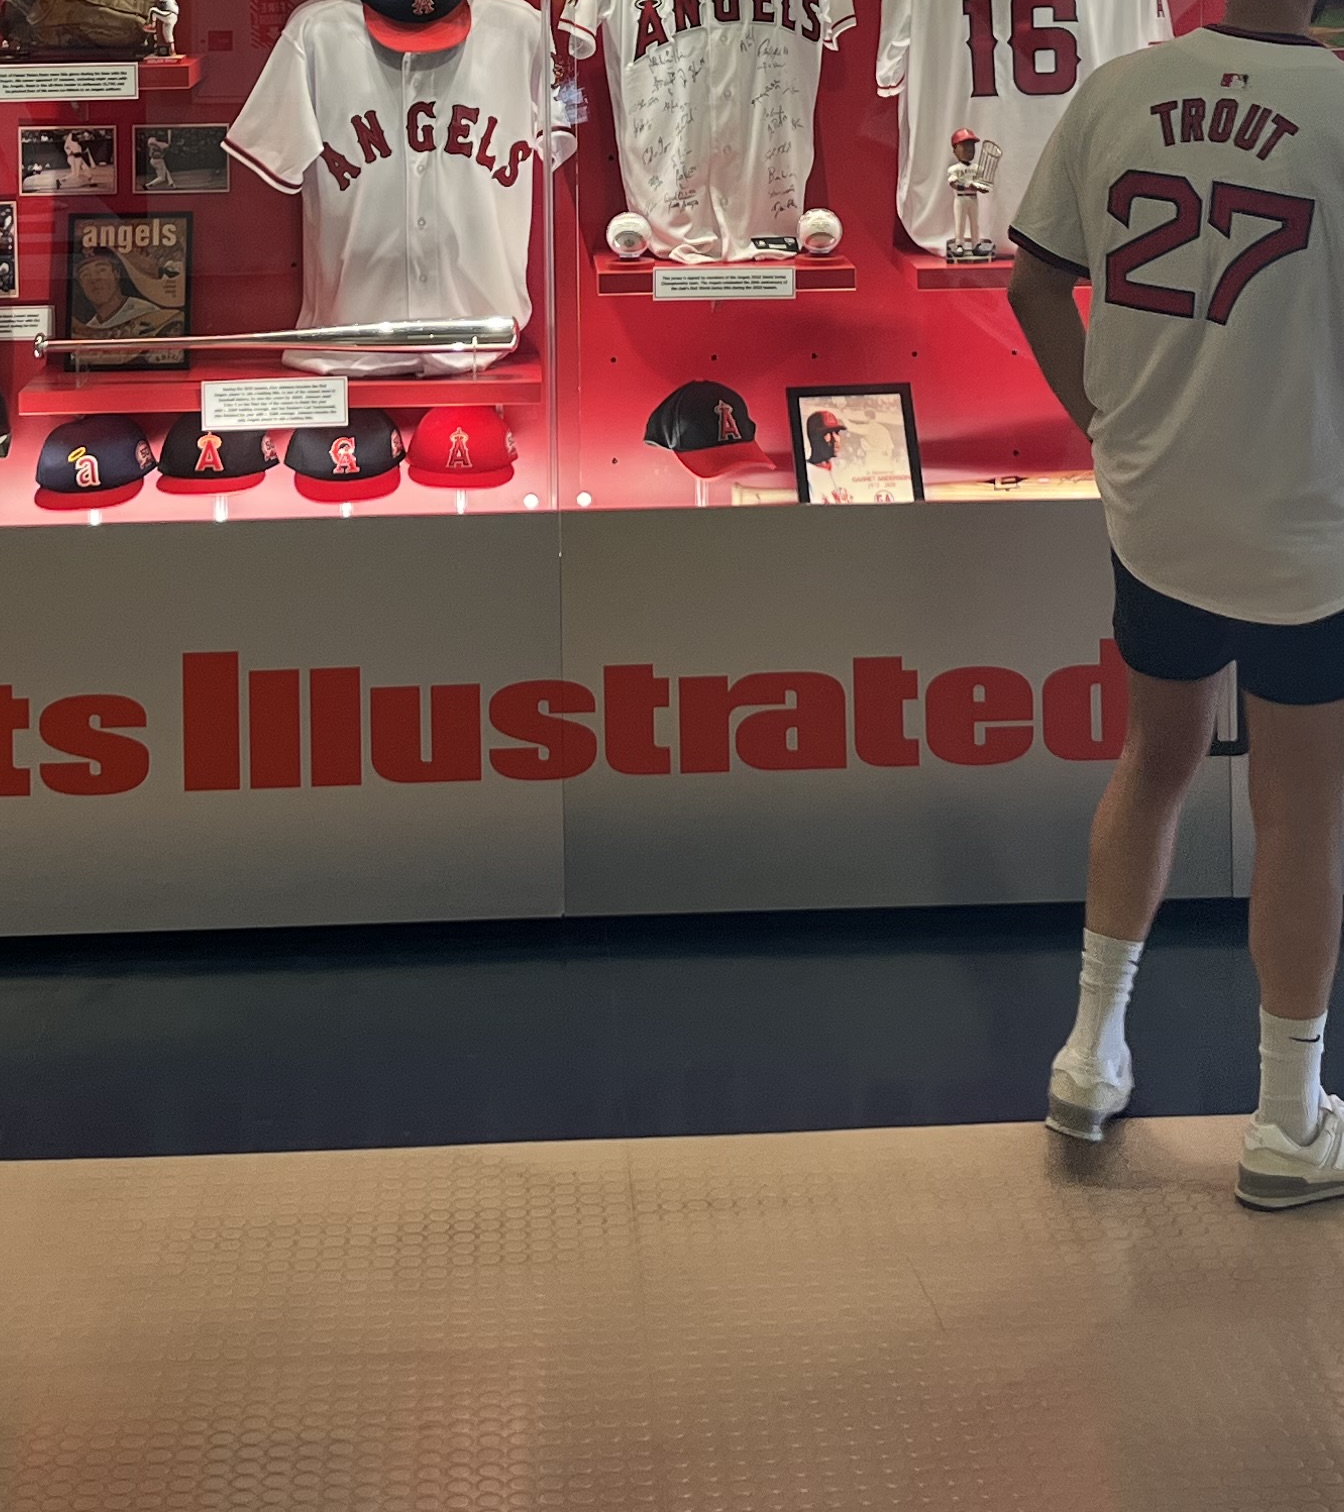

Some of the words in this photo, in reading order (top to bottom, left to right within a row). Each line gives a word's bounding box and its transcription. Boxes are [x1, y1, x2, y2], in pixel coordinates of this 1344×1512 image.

[321, 101, 533, 191] ANGELS
[1151, 98, 1300, 161] TROUT
[83, 220, 177, 254] angels
[1104, 168, 1316, 327] 27
[713, 399, 742, 441] A
[195, 432, 224, 472] A
[446, 427, 473, 468] A
[181, 639, 1127, 793] Illustrated
